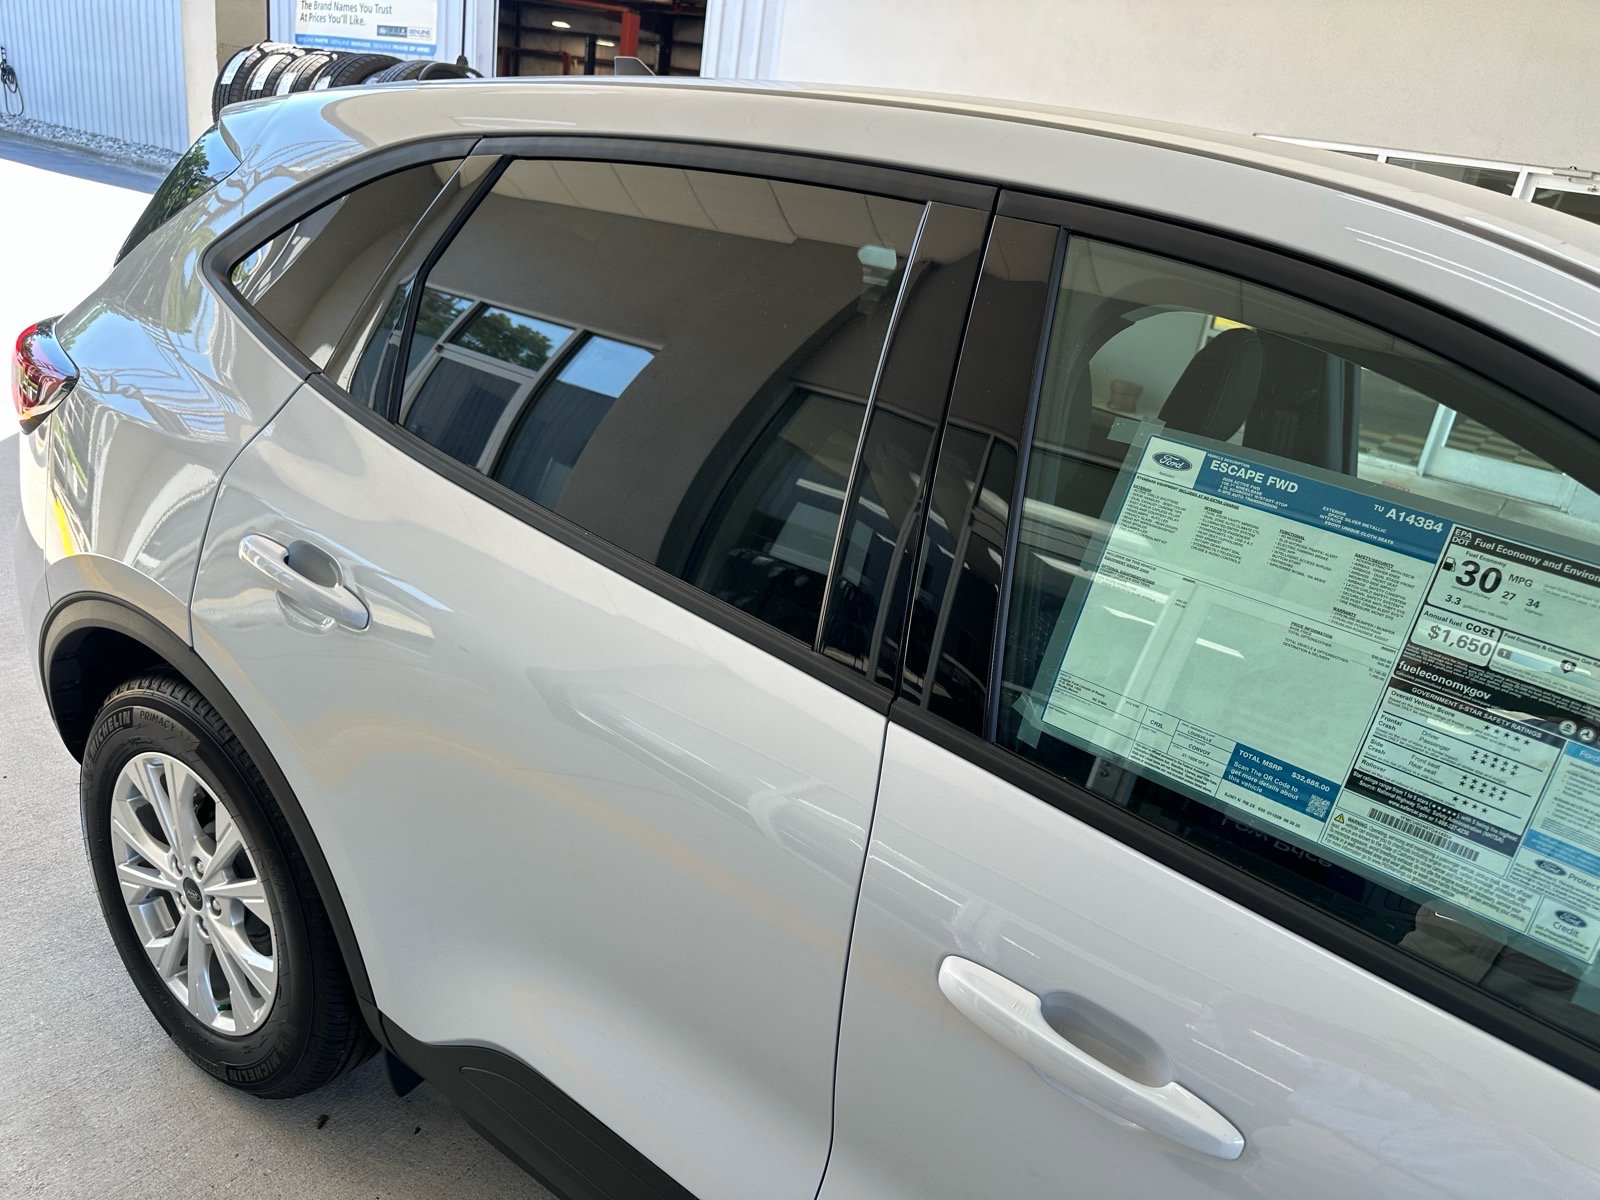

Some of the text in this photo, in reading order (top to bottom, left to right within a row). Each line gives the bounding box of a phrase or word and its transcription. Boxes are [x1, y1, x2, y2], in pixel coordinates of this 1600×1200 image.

[301, 0, 392, 15] The Brand Names You Trust
[300, 13, 366, 26] At Prices You'll Like.
[1209, 459, 1300, 494] ESCAPE FWD
[1322, 506, 1346, 517] EXTERIOR
[1372, 504, 1384, 512] TU
[1318, 514, 1342, 524] INTERIOR
[1327, 512, 1387, 533] SPACE SILVER METALLIC
[1384, 507, 1444, 533] A14384
[1359, 531, 1377, 540] CLOTH
[1376, 536, 1394, 545] SEATS
[1451, 535, 1470, 546] DOT
[1454, 528, 1473, 539] EPA
[1464, 550, 1507, 569] Fuel Economy
[1473, 537, 1496, 550] Fuel
[1494, 544, 1542, 567] Economy
[1541, 557, 1563, 570] and
[1452, 557, 1506, 596] 30
[1507, 573, 1534, 588] MPG
[1443, 593, 1462, 606] 3.3
[1501, 590, 1516, 601] 27
[1525, 598, 1541, 609] 34
[1423, 609, 1449, 623] Annual
[1448, 617, 1463, 627] fuel
[1464, 620, 1496, 638] cost
[1425, 623, 1493, 659] $1,650
[1563, 661, 1572, 670] 6
[1396, 660, 1492, 702] fueleconomy.gov
[1390, 689, 1456, 717] Overall Vehicle Score
[1380, 714, 1402, 726] Frontal
[1411, 686, 1542, 738] GOVERNMENT 5-STAR SAFETY RATINGS
[140, 710, 177, 732] PRIMACY
[1377, 720, 1396, 731] Crash
[89, 709, 132, 760] MICHELIN
[1420, 730, 1439, 740] Driver
[1187, 743, 1210, 756] CONVOY
[1367, 744, 1386, 755] Crash
[1369, 738, 1384, 748] Side
[1418, 736, 1450, 752] Passenger
[1361, 759, 1386, 773] Rollover
[1408, 760, 1436, 775] Rear seat
[1410, 754, 1440, 770] Front seat
[1233, 760, 1249, 772] Scan
[1249, 767, 1263, 777] The
[1262, 773, 1273, 782] QR
[1273, 777, 1291, 789] Code
[1238, 749, 1330, 794] TOTAL MSRP $32,685.00
[1227, 774, 1263, 793] this vehicle
[1230, 767, 1298, 800] get more details about
[1352, 770, 1364, 779] Star
[1362, 775, 1378, 786] ratings
[1377, 782, 1392, 792] range
[1391, 786, 1404, 796] from
[1415, 796, 1429, 806] stars
[1460, 814, 1472, 824] with
[1474, 820, 1490, 832] being
[1489, 826, 1498, 834] the
[1358, 779, 1376, 791] Source:
[1375, 787, 1396, 799] National
[1394, 795, 1416, 808] Highway
[1414, 803, 1431, 814] Traffic
[1431, 810, 1448, 821] Safety
[1446, 816, 1483, 835] Administration
[1387, 799, 1428, 820] www.safercar.gov
[1551, 920, 1580, 938] Credit
